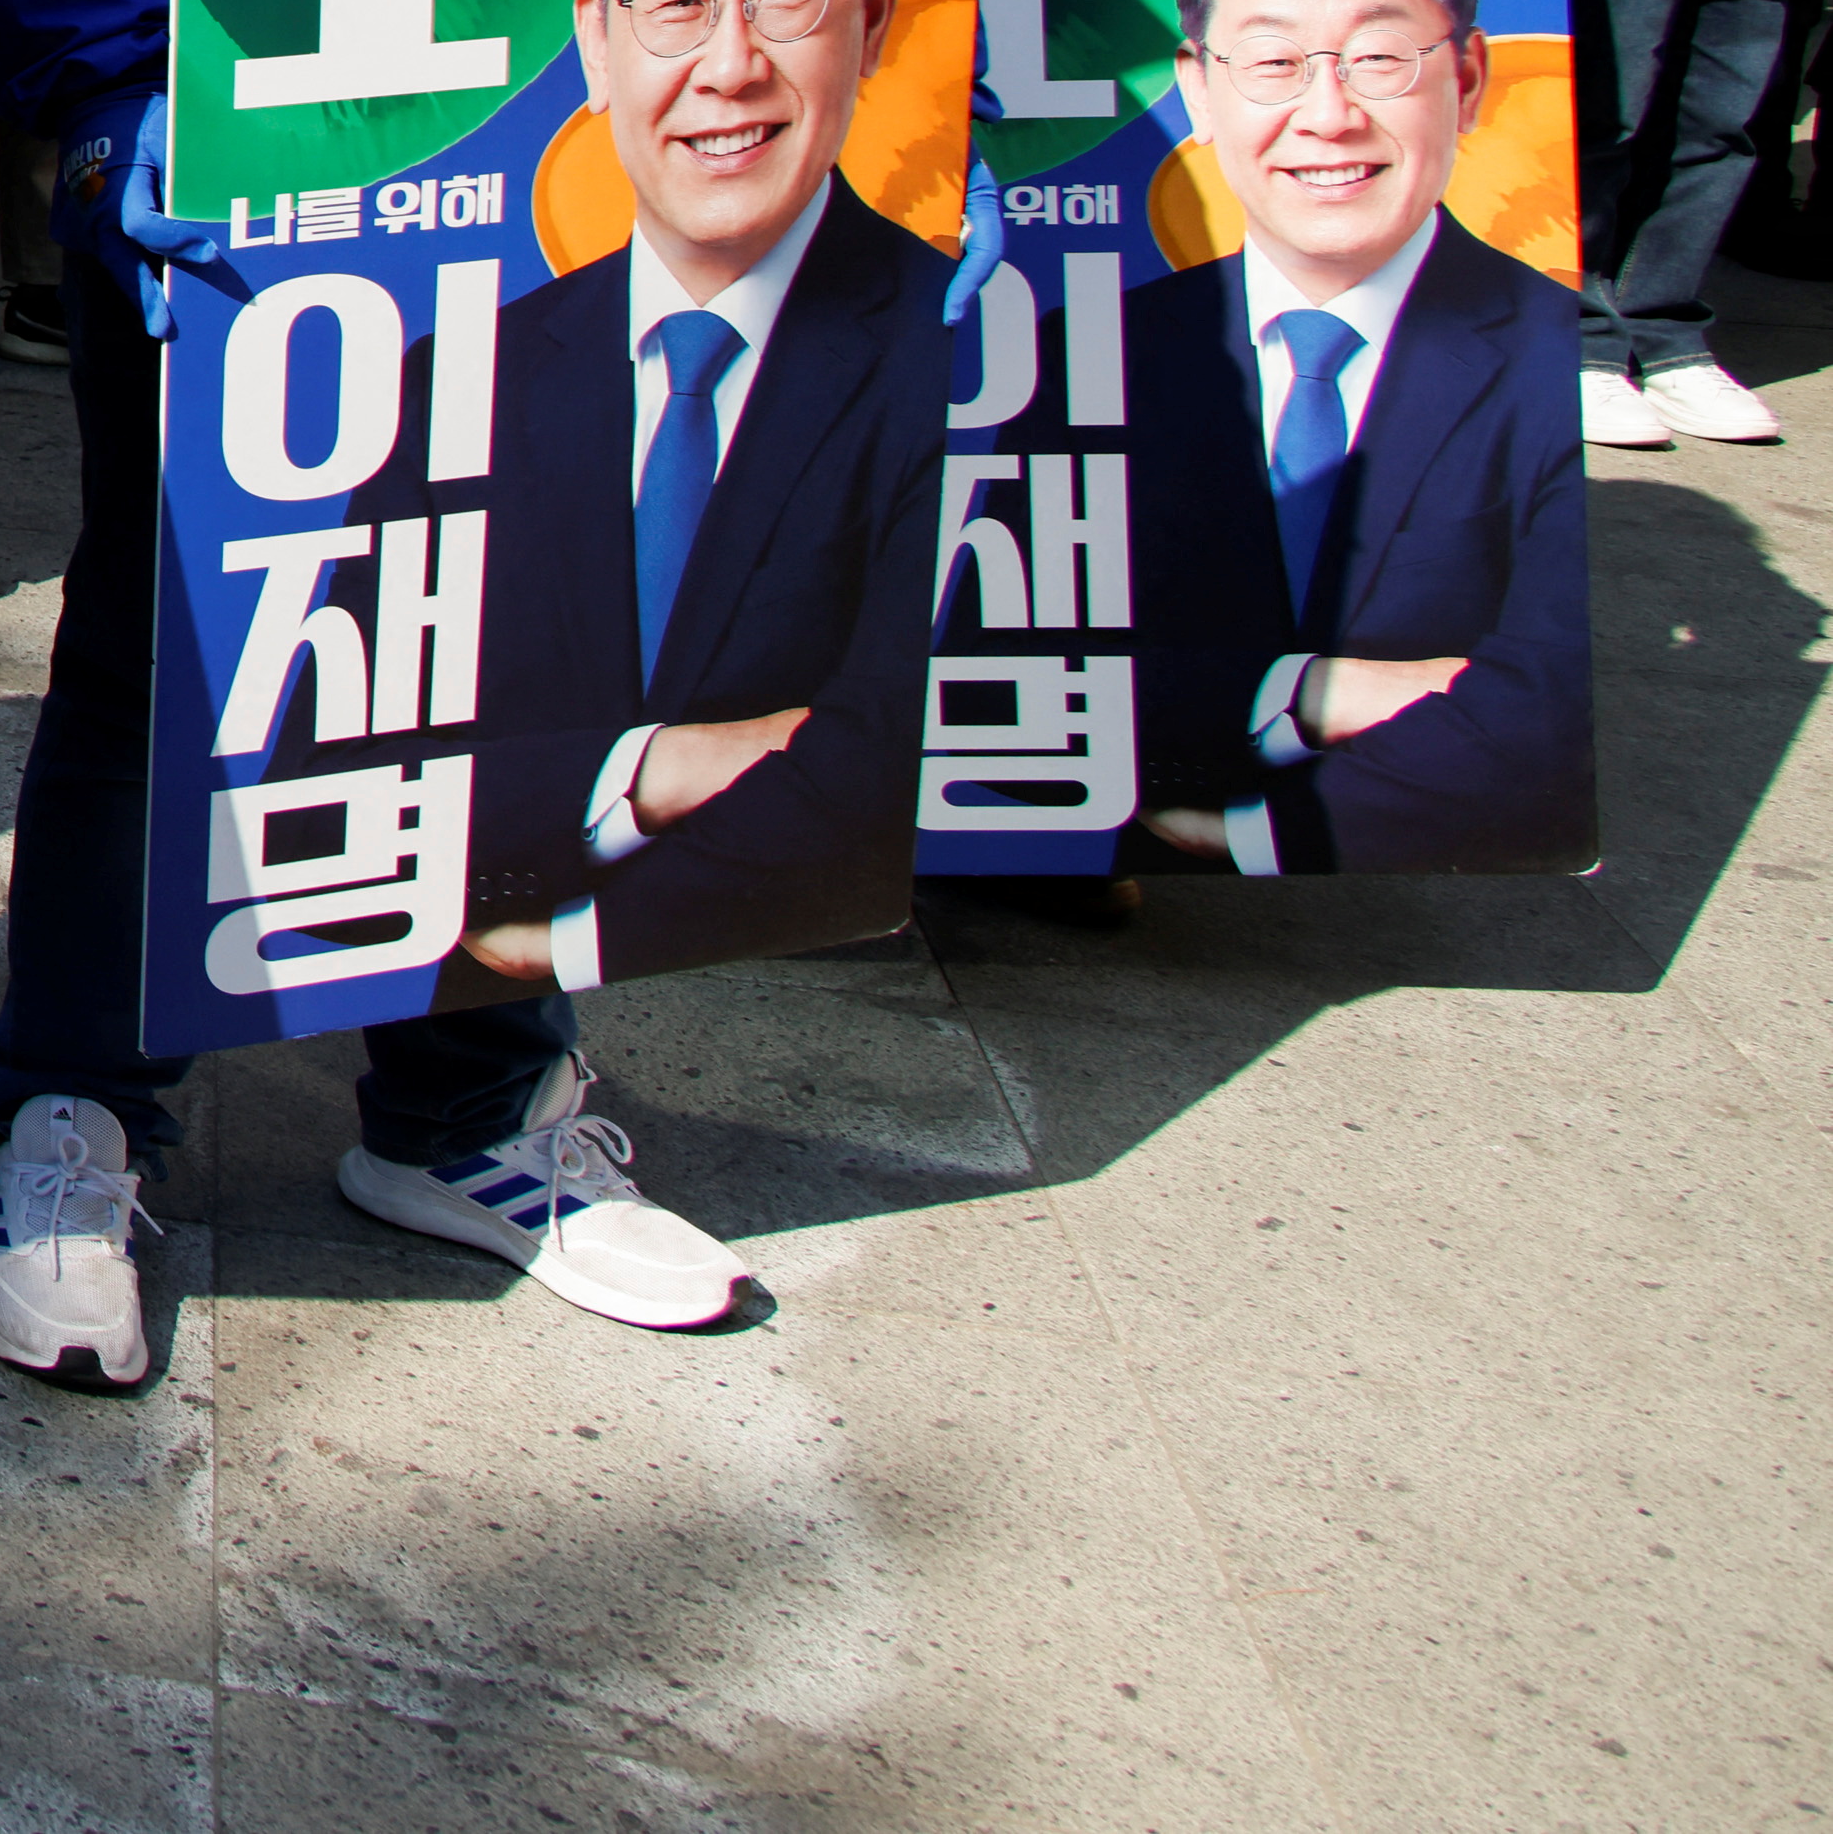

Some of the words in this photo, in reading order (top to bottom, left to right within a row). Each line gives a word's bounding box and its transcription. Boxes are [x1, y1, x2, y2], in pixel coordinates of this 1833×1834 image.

[229, 184, 367, 250] 나를
[374, 173, 504, 235] 위해
[1005, 184, 1119, 226] 위해
[206, 257, 501, 995] 이재명
